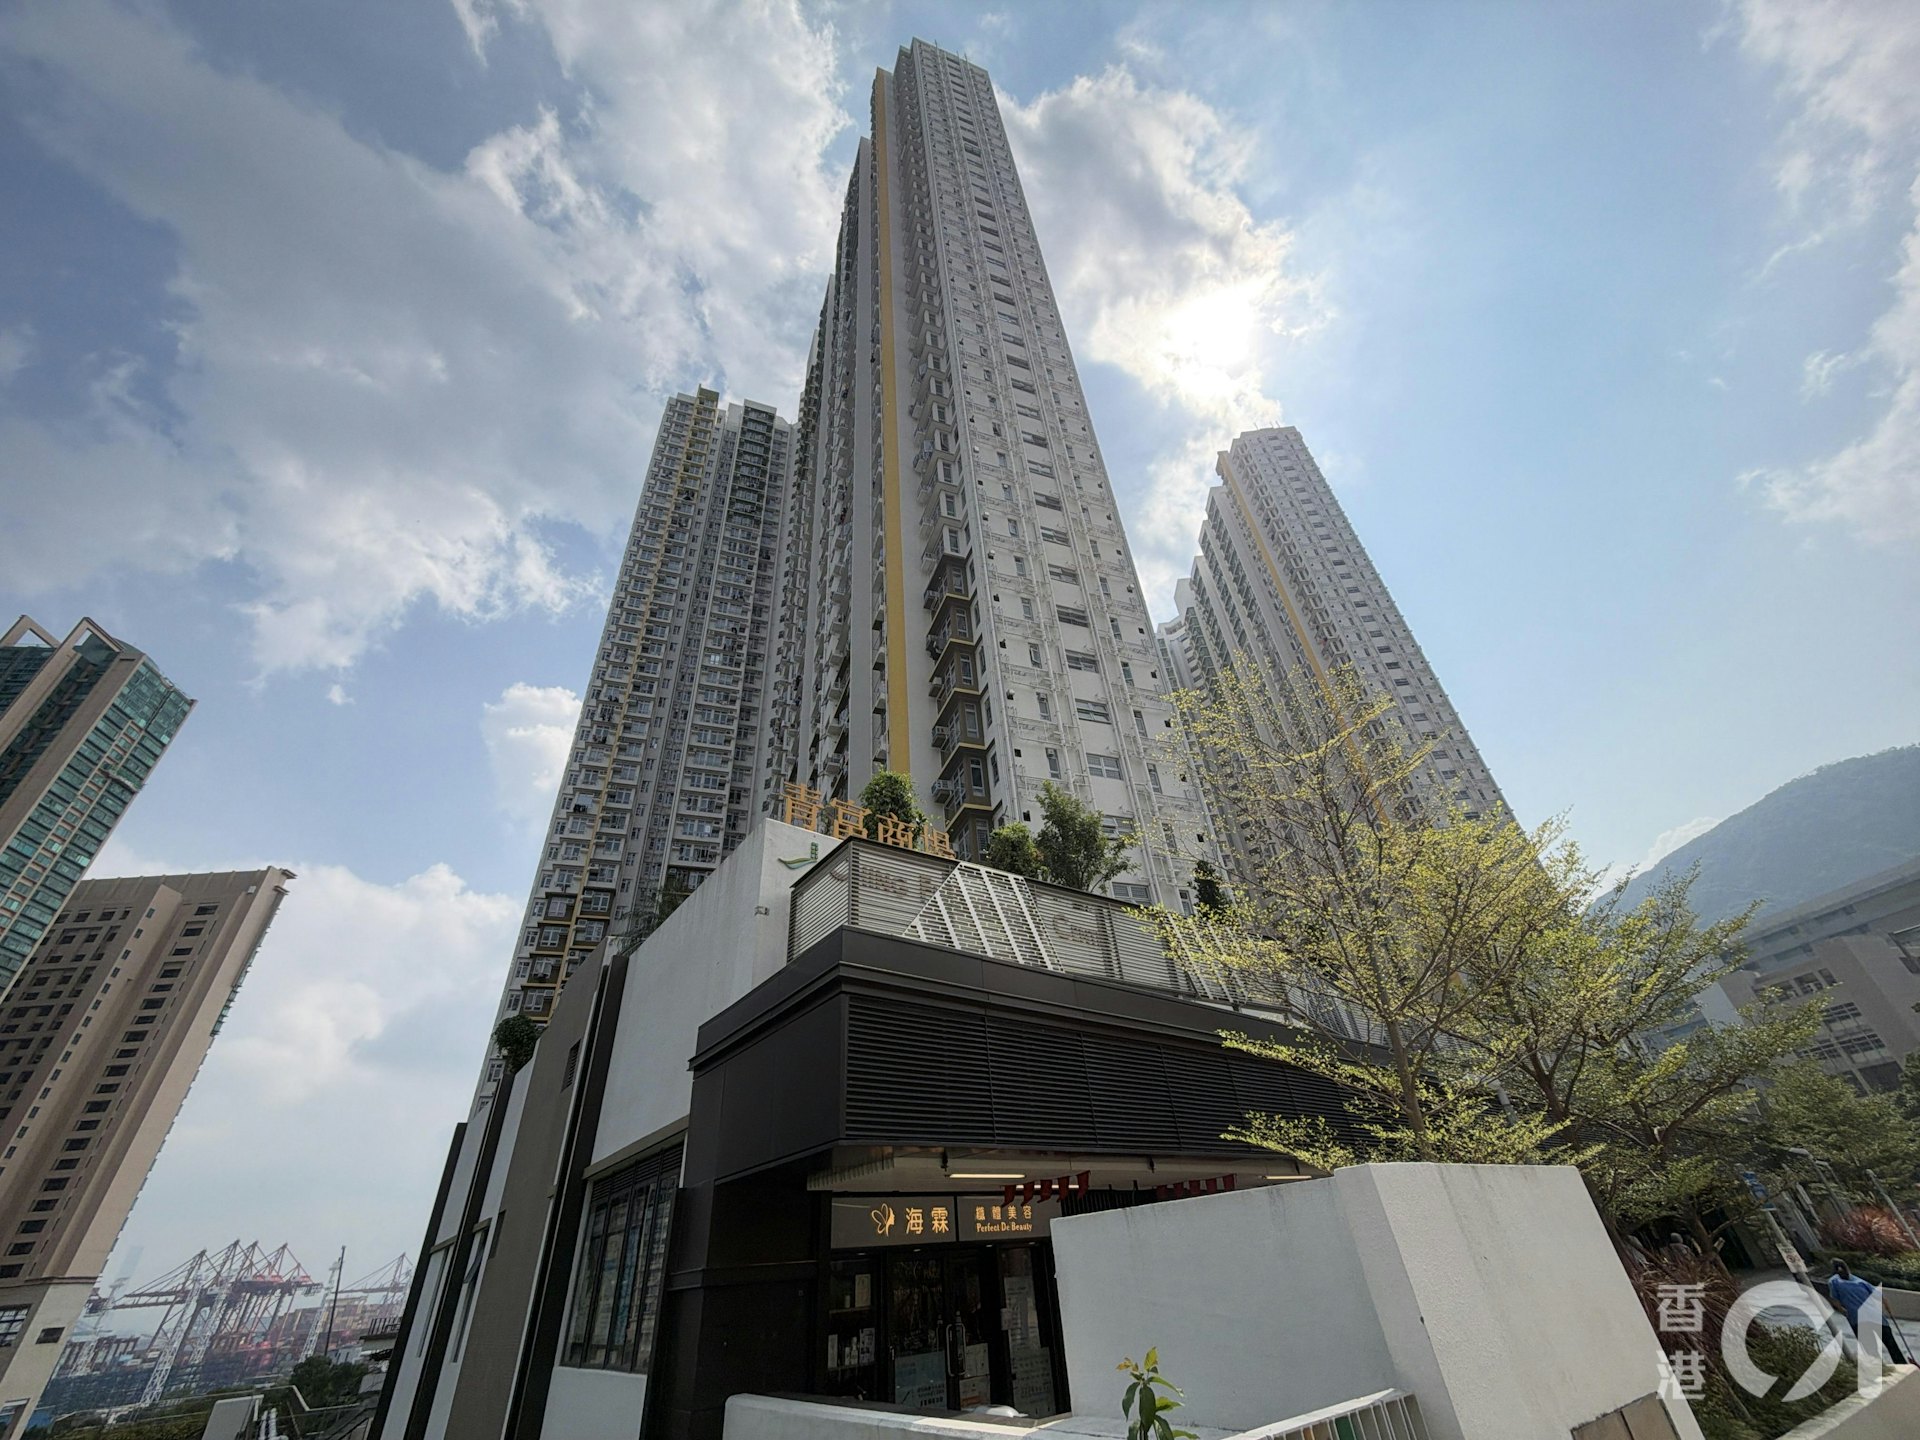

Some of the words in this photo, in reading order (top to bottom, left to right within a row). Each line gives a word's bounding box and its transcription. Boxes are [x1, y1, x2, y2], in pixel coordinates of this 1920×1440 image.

[905, 1207, 949, 1235] 海霖
[976, 1222, 1000, 1232] Perfect
[1001, 1222, 1010, 1231] De
[1011, 1222, 1032, 1232] Beauty
